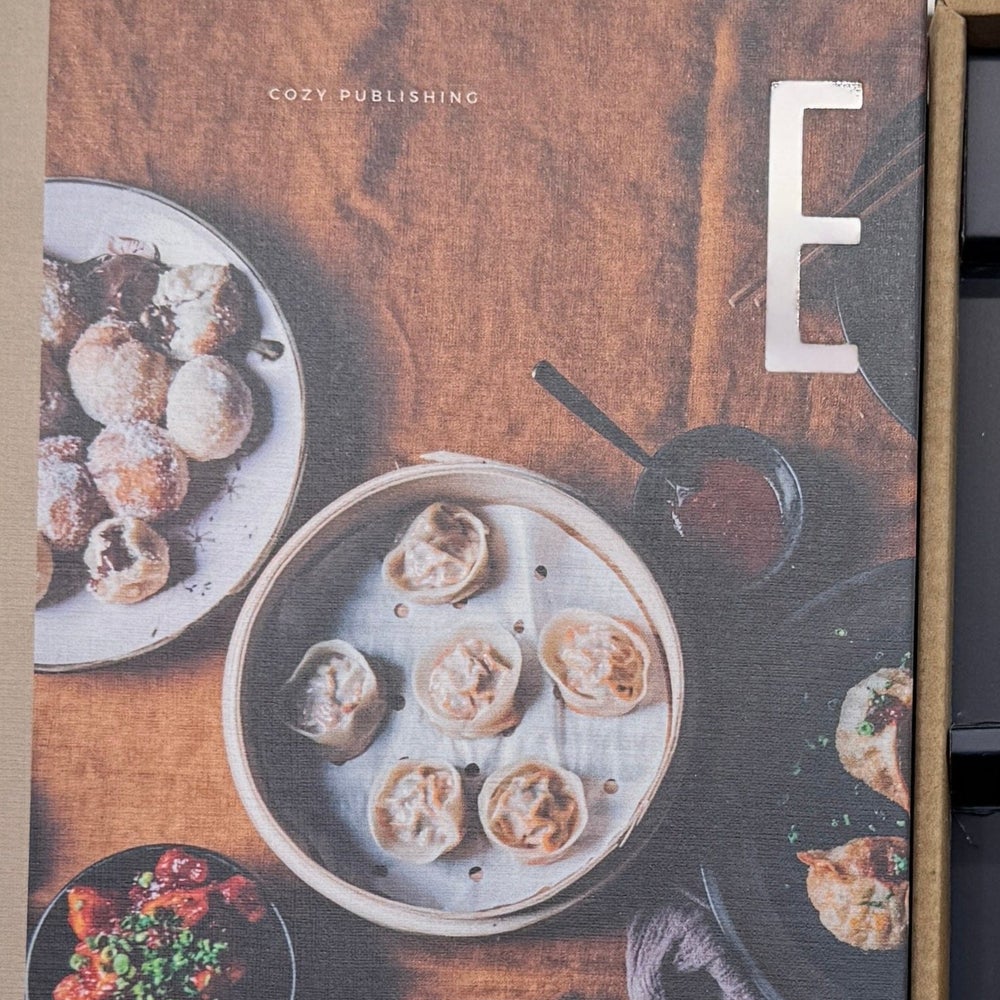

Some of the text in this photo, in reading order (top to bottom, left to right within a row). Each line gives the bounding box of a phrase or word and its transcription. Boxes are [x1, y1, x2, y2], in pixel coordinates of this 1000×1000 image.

[268, 88, 479, 104] COZY PUBLISHING
[765, 80, 863, 373] E
